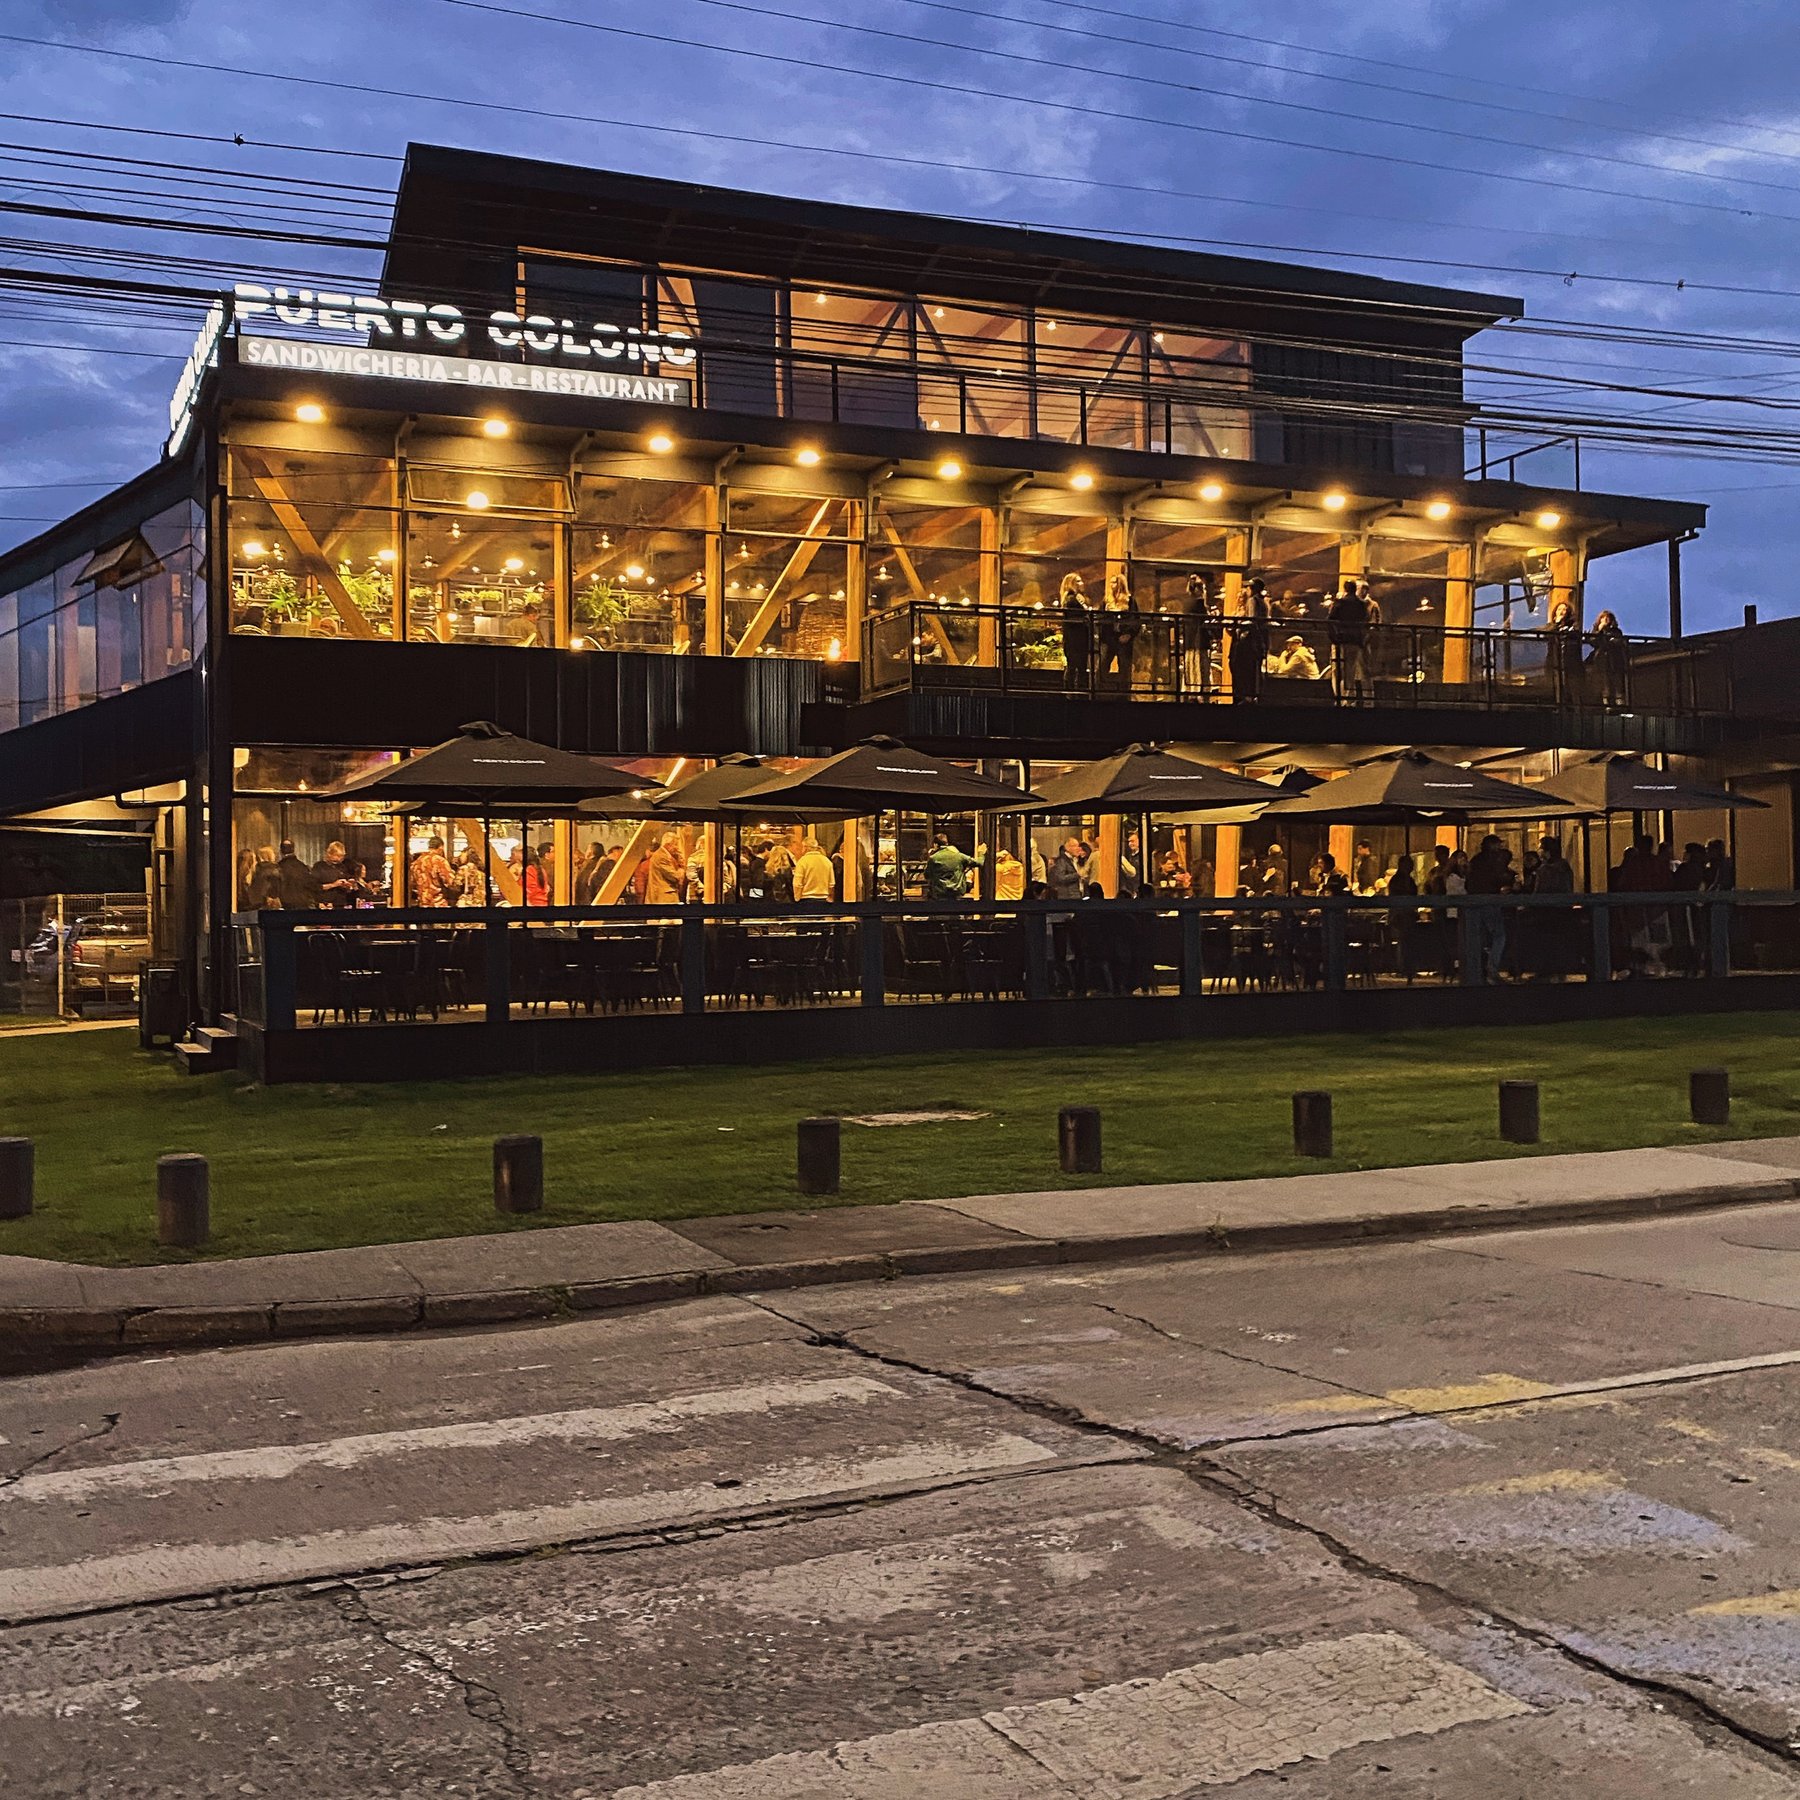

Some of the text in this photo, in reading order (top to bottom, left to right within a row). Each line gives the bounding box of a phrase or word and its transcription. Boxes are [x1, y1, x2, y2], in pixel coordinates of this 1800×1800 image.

[234, 283, 698, 366] PUERTO COLONO
[247, 341, 449, 380] SANDWICHERIA
[467, 363, 514, 387] BAR
[530, 369, 680, 403] RESTAURANT
